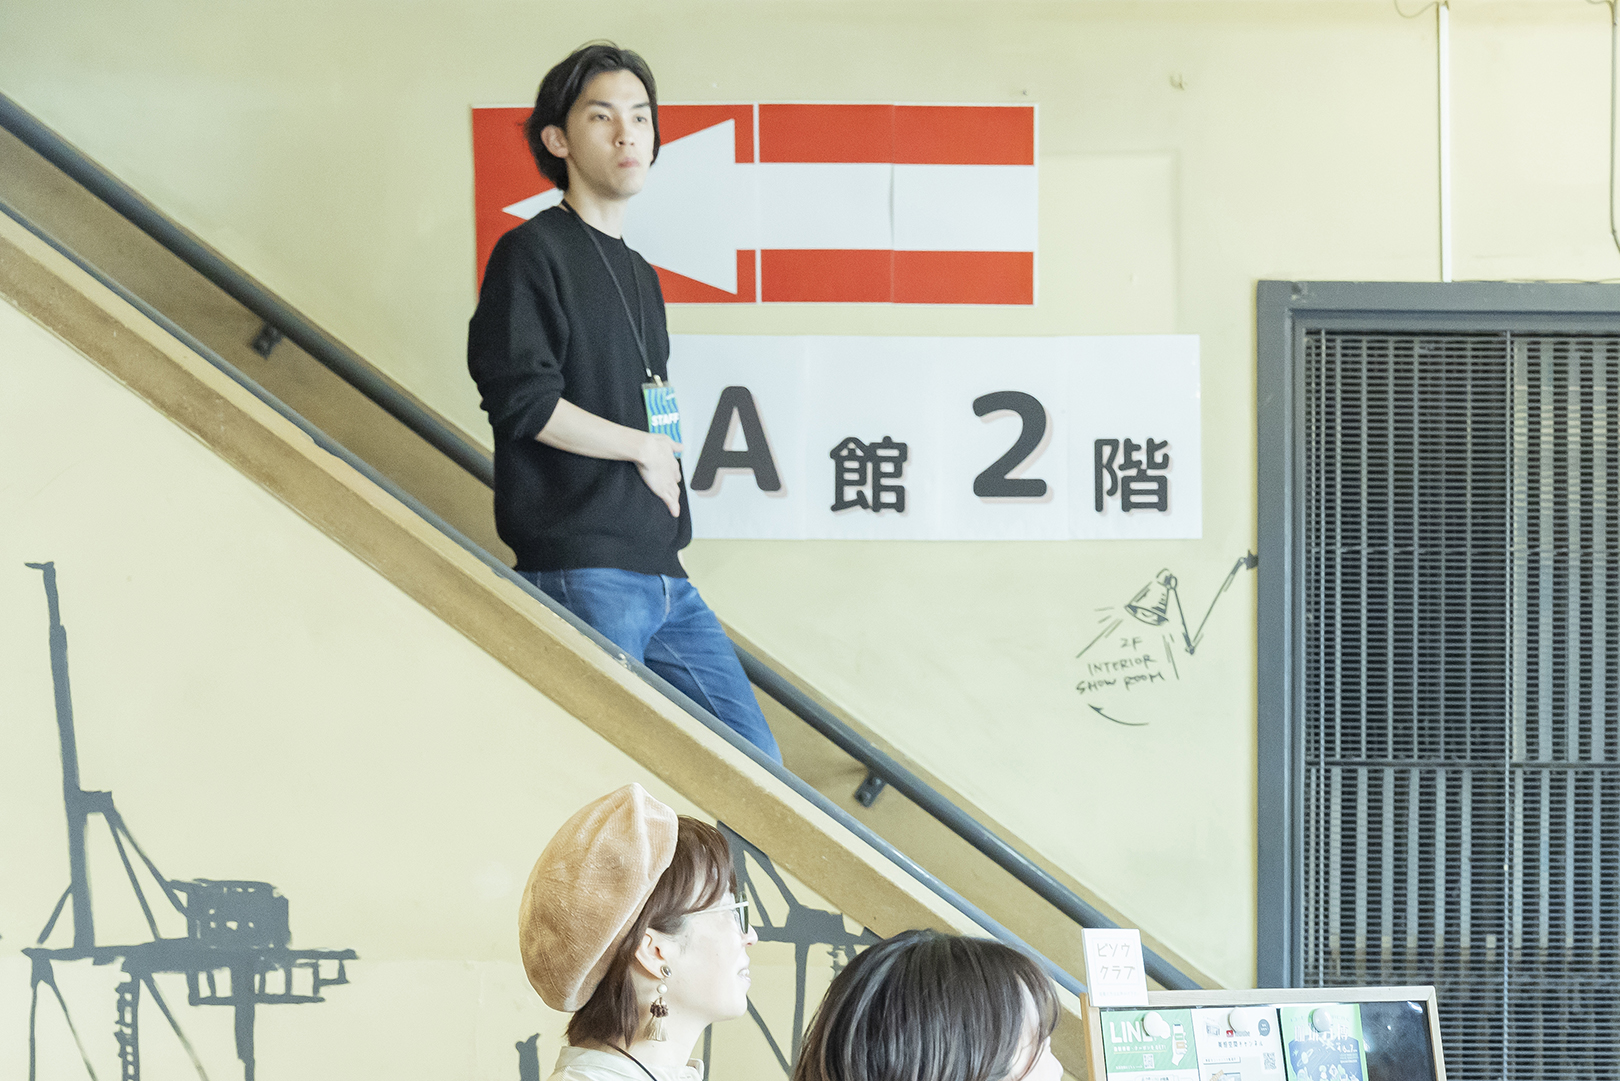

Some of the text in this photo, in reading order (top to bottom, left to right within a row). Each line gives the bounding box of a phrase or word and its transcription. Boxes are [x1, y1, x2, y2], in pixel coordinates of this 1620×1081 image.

[651, 412, 680, 427] STAFF
[1120, 636, 1143, 651] 2F
[1087, 655, 1157, 677] INTERIOR
[1076, 671, 1165, 695] SHOW ROOM
[1097, 942, 1130, 957] ビソウ
[1100, 965, 1135, 980] クラブ
